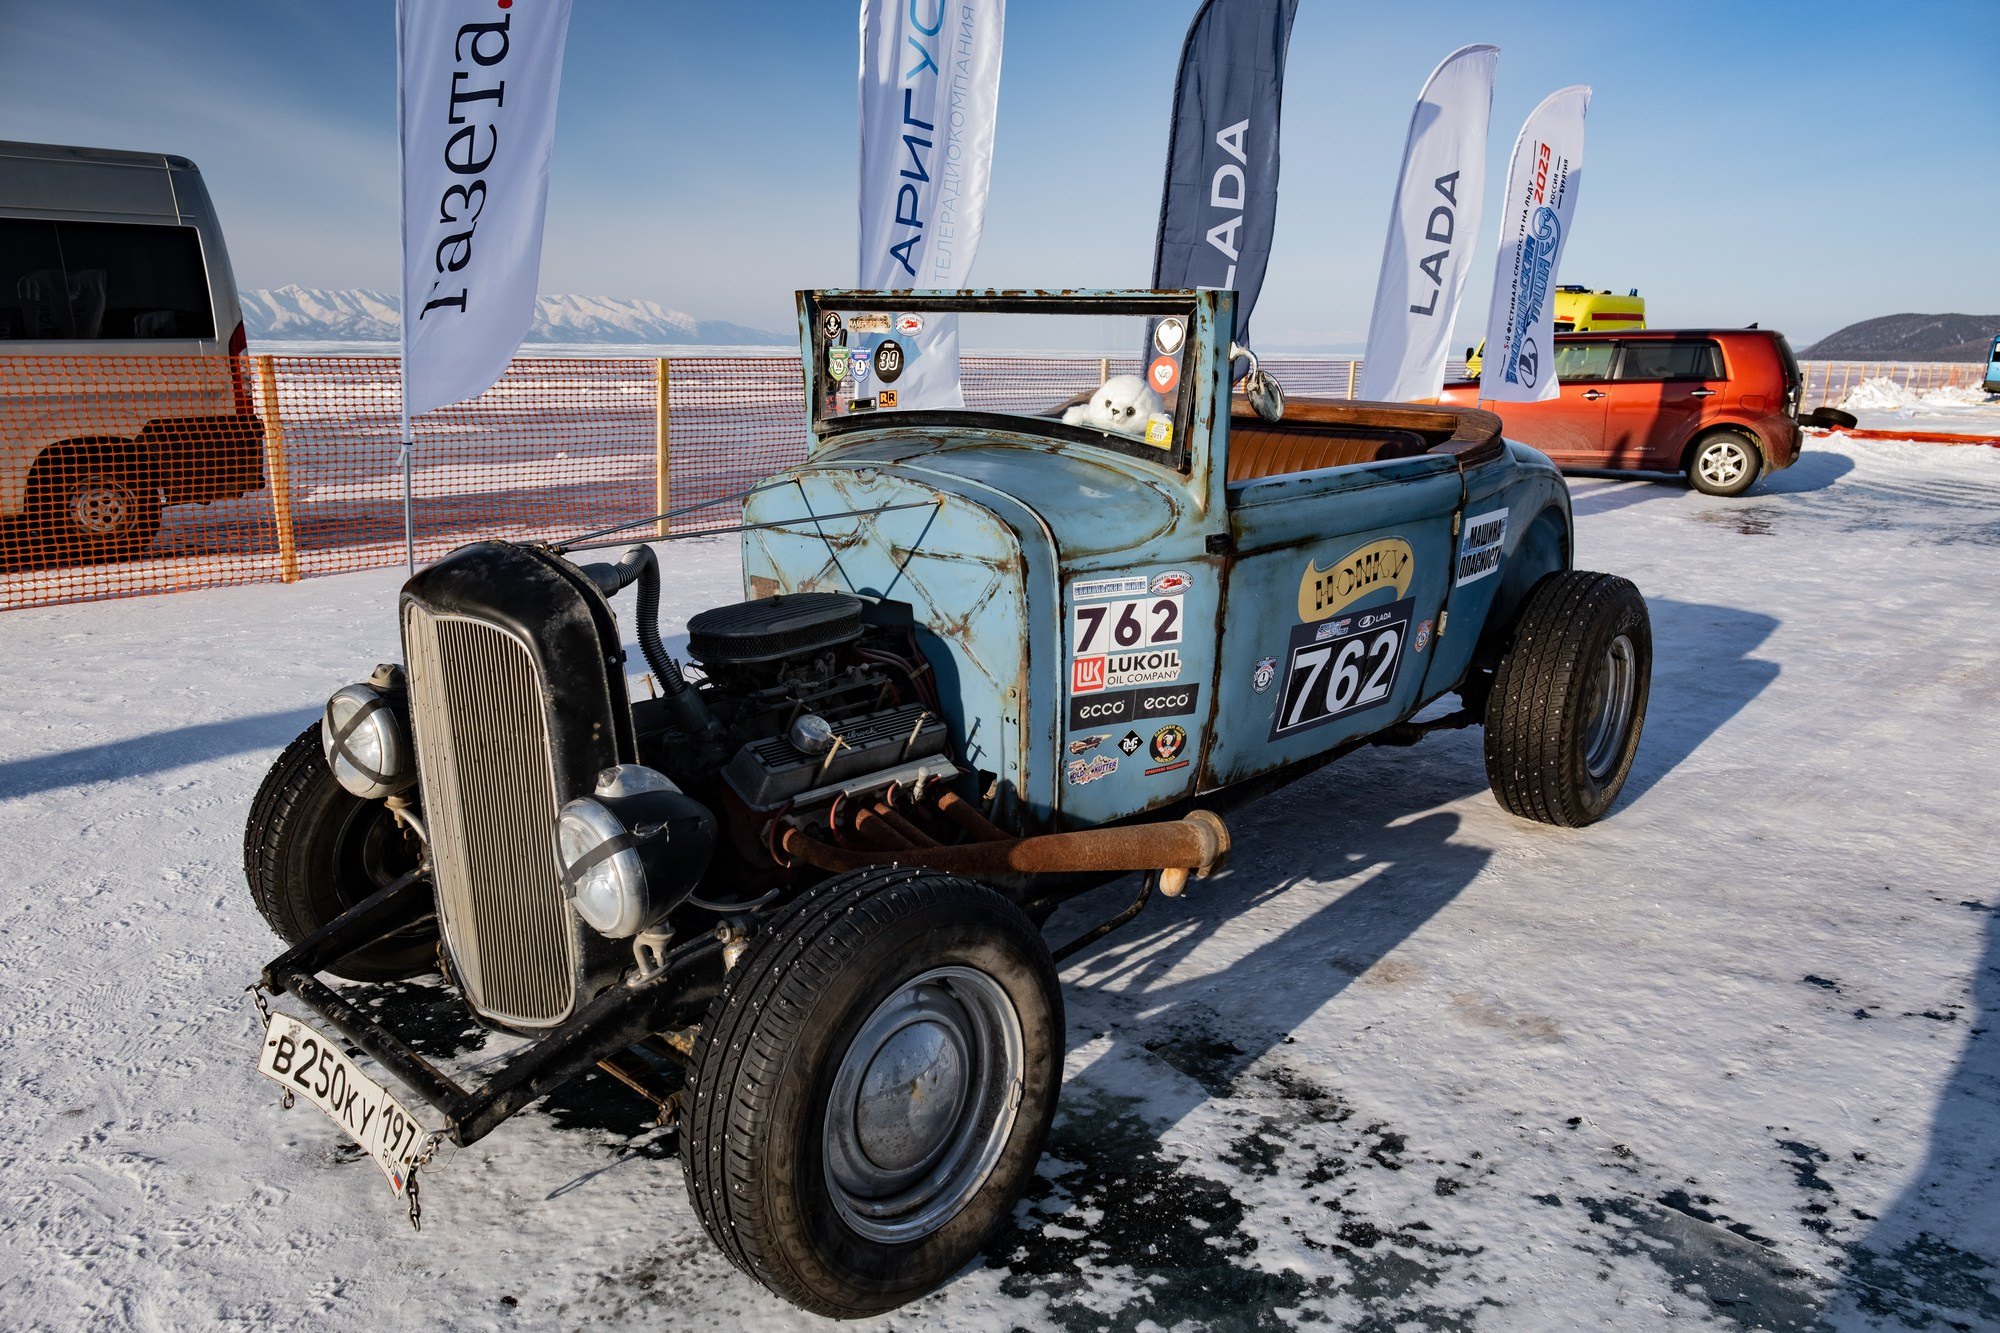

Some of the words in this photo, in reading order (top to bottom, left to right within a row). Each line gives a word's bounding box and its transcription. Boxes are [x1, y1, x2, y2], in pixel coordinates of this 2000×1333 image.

[934, 5, 975, 282] ТЕЛЕРАДИОКОМПАНИЯ
[1533, 142, 1551, 205] 2023
[1549, 173, 1559, 205] РОССИЯ
[1559, 159, 1569, 194] БУРЯТИЯ
[1197, 118, 1249, 290] LADA
[1409, 170, 1460, 317] LADA
[1506, 278, 1518, 334] ФЕСТИВАЛЬ
[1513, 224, 1526, 276] СКОРОСТИ
[1521, 209, 1529, 223] НА
[1525, 180, 1534, 207] ЛЬДУ
[879, 350, 900, 371] 39
[1315, 550, 1408, 611] HONKY
[1076, 599, 1178, 653] 762
[1376, 612, 1392, 623] LADA
[1107, 675, 1124, 686] OIL
[1127, 670, 1179, 684] COMPANY
[1108, 652, 1180, 674] LUKOIL
[1288, 629, 1399, 726] 762
[1080, 700, 1126, 719] ecco
[1143, 692, 1190, 710] ecco
[382, 1103, 417, 1163] 197
[382, 1148, 398, 1176] RUS
